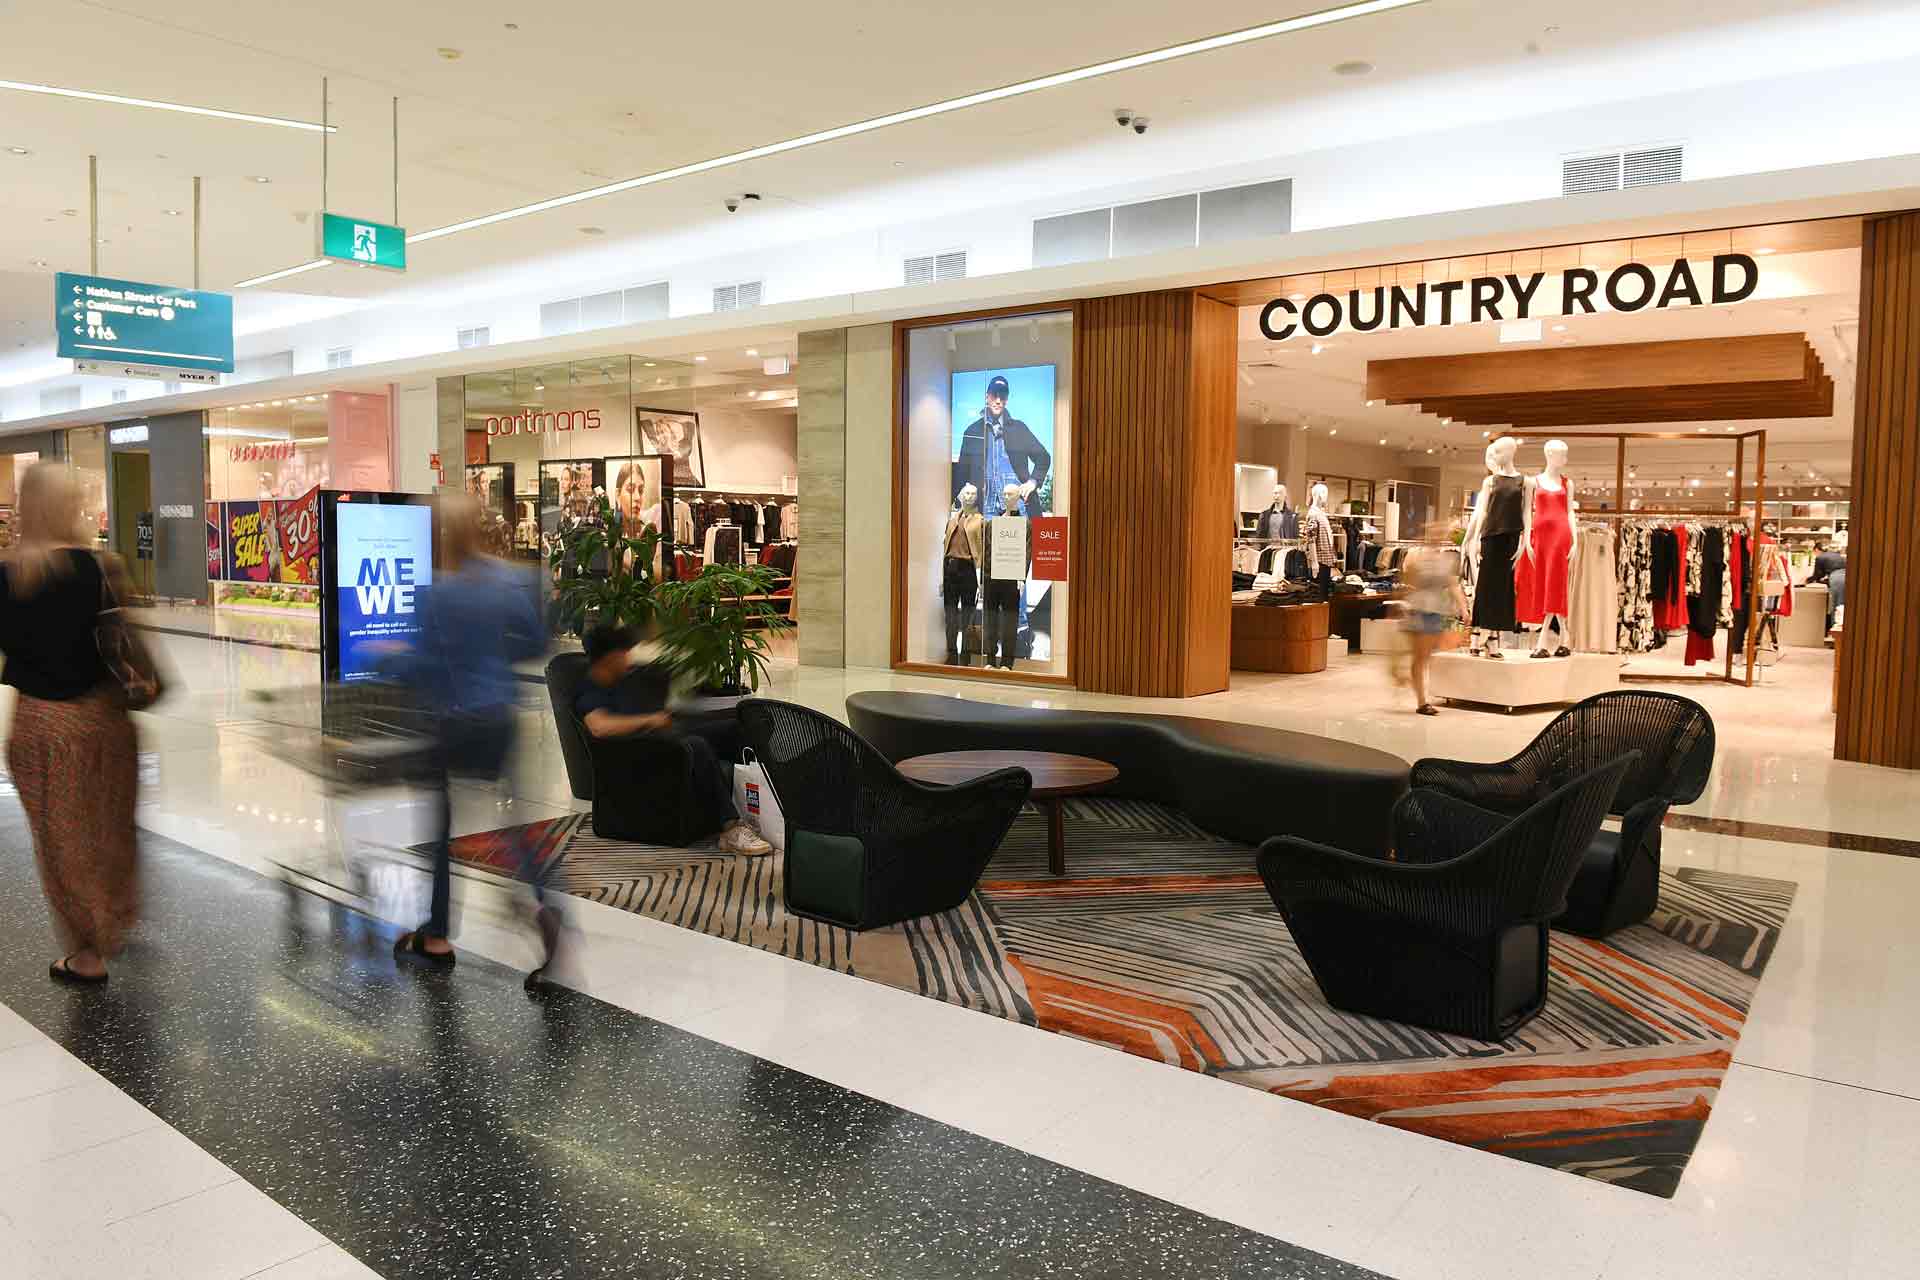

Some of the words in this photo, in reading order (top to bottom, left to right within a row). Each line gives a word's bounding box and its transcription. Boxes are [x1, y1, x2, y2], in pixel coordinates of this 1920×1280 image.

[86, 300, 135, 314] Customer
[136, 306, 159, 317] Care
[124, 291, 155, 303] Street
[156, 295, 174, 306] Car
[175, 297, 197, 309] Park
[1259, 272, 1545, 340] COUNTRY
[1562, 252, 1759, 315] ROAD
[486, 408, 601, 436] portmans
[231, 511, 261, 538] SUPER
[1040, 530, 1061, 539] SALE
[235, 533, 266, 569] SALE
[357, 557, 414, 586] ME
[356, 585, 416, 615] WE
